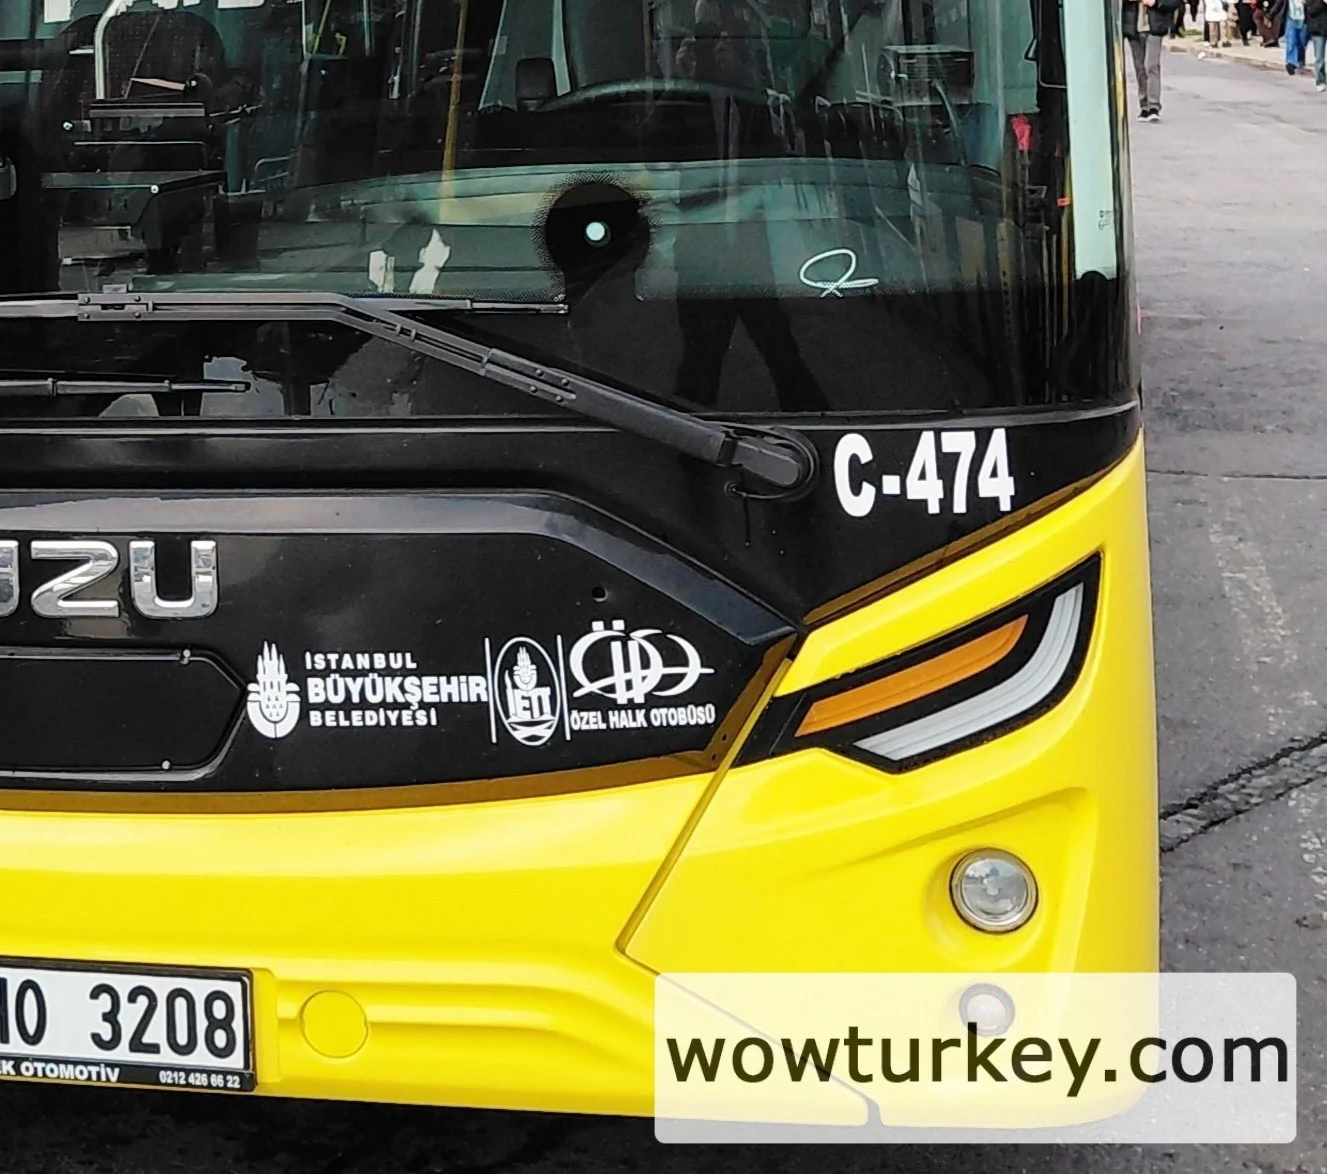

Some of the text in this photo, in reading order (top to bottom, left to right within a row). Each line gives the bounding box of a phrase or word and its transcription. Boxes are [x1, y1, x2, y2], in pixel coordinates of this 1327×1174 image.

[834, 428, 1015, 517] C-474
[309, 706, 437, 727] BELEDİYESİ
[571, 708, 606, 730] ÖZEL
[608, 708, 648, 729] HALK
[89, 983, 236, 1058] 3208
[21, 1060, 120, 1083] OTOMOTİV
[159, 1070, 186, 1084] 0212
[188, 1072, 208, 1085] 426
[226, 1076, 241, 1088] 22
